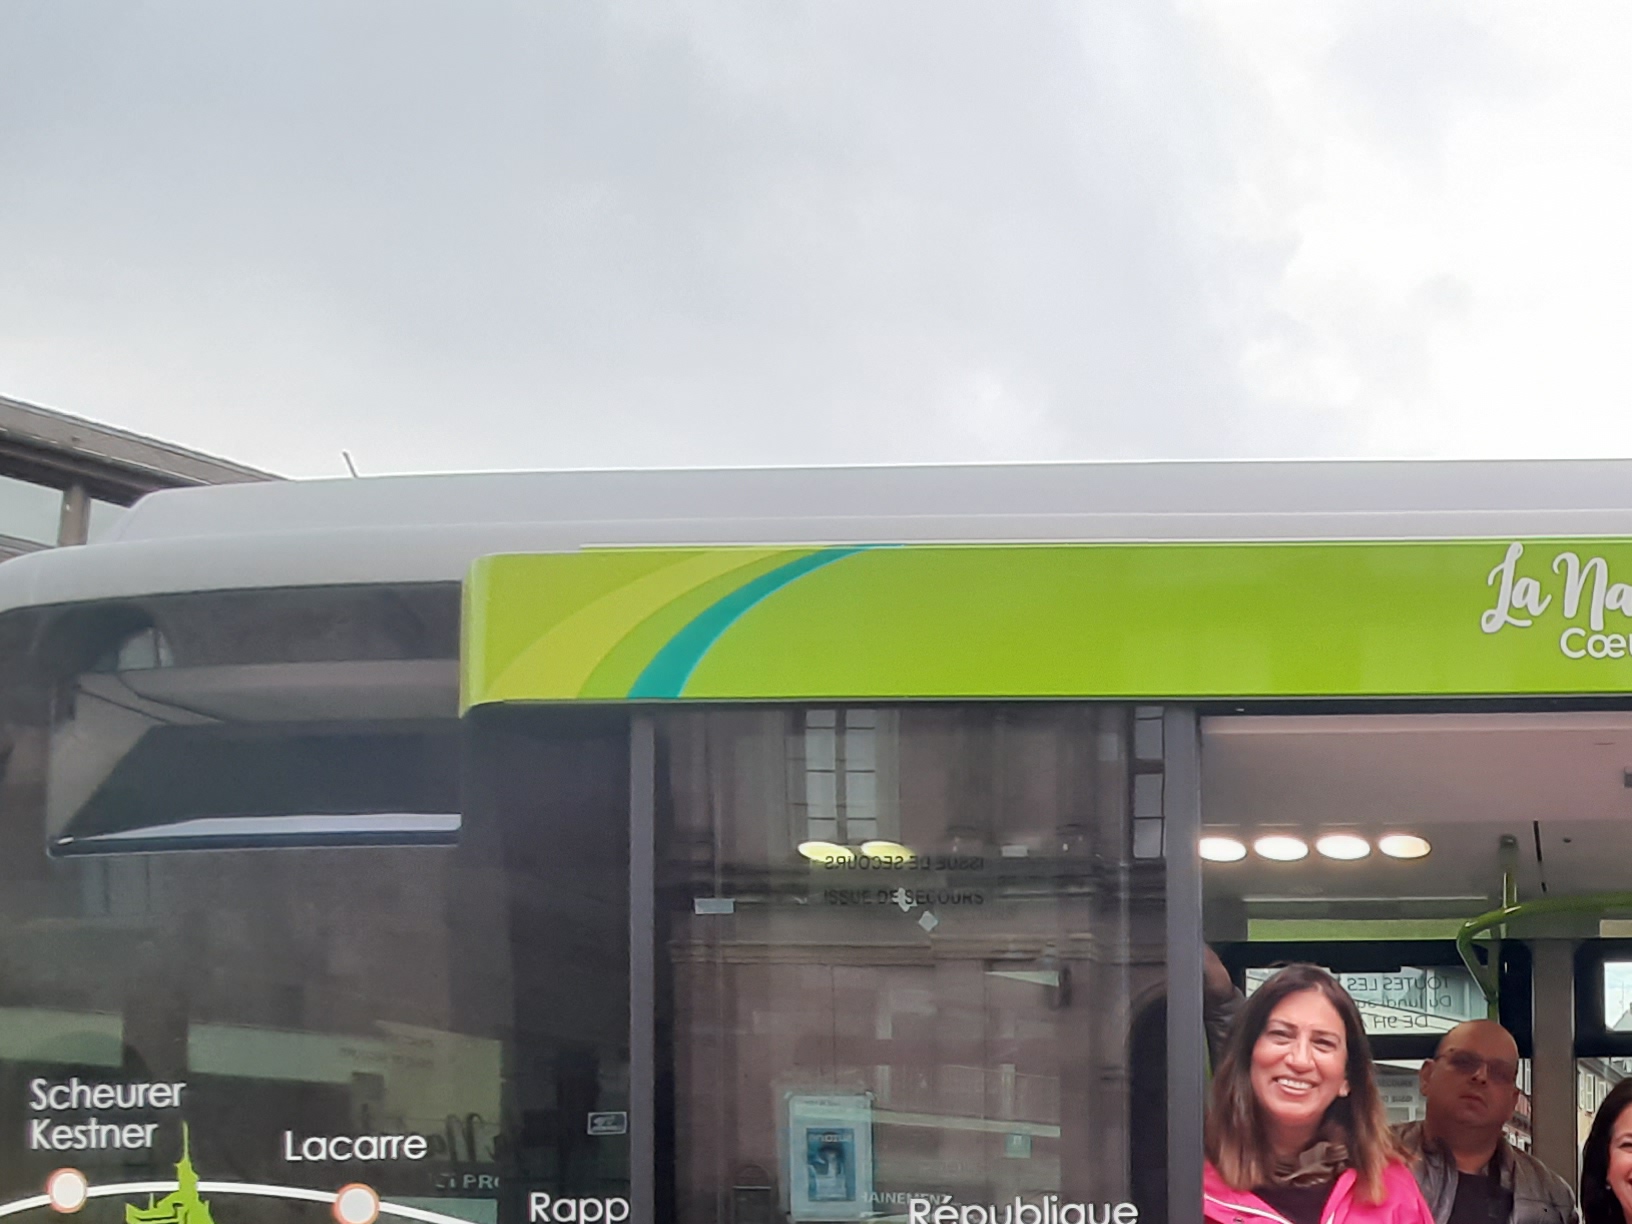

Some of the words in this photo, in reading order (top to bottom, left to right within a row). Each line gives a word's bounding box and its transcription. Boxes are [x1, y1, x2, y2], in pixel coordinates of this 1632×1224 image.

[1480, 541, 1552, 633] La
[29, 1077, 187, 1111] Scheurer
[29, 1118, 159, 1150] Kestner
[283, 1130, 428, 1162] Lacarre
